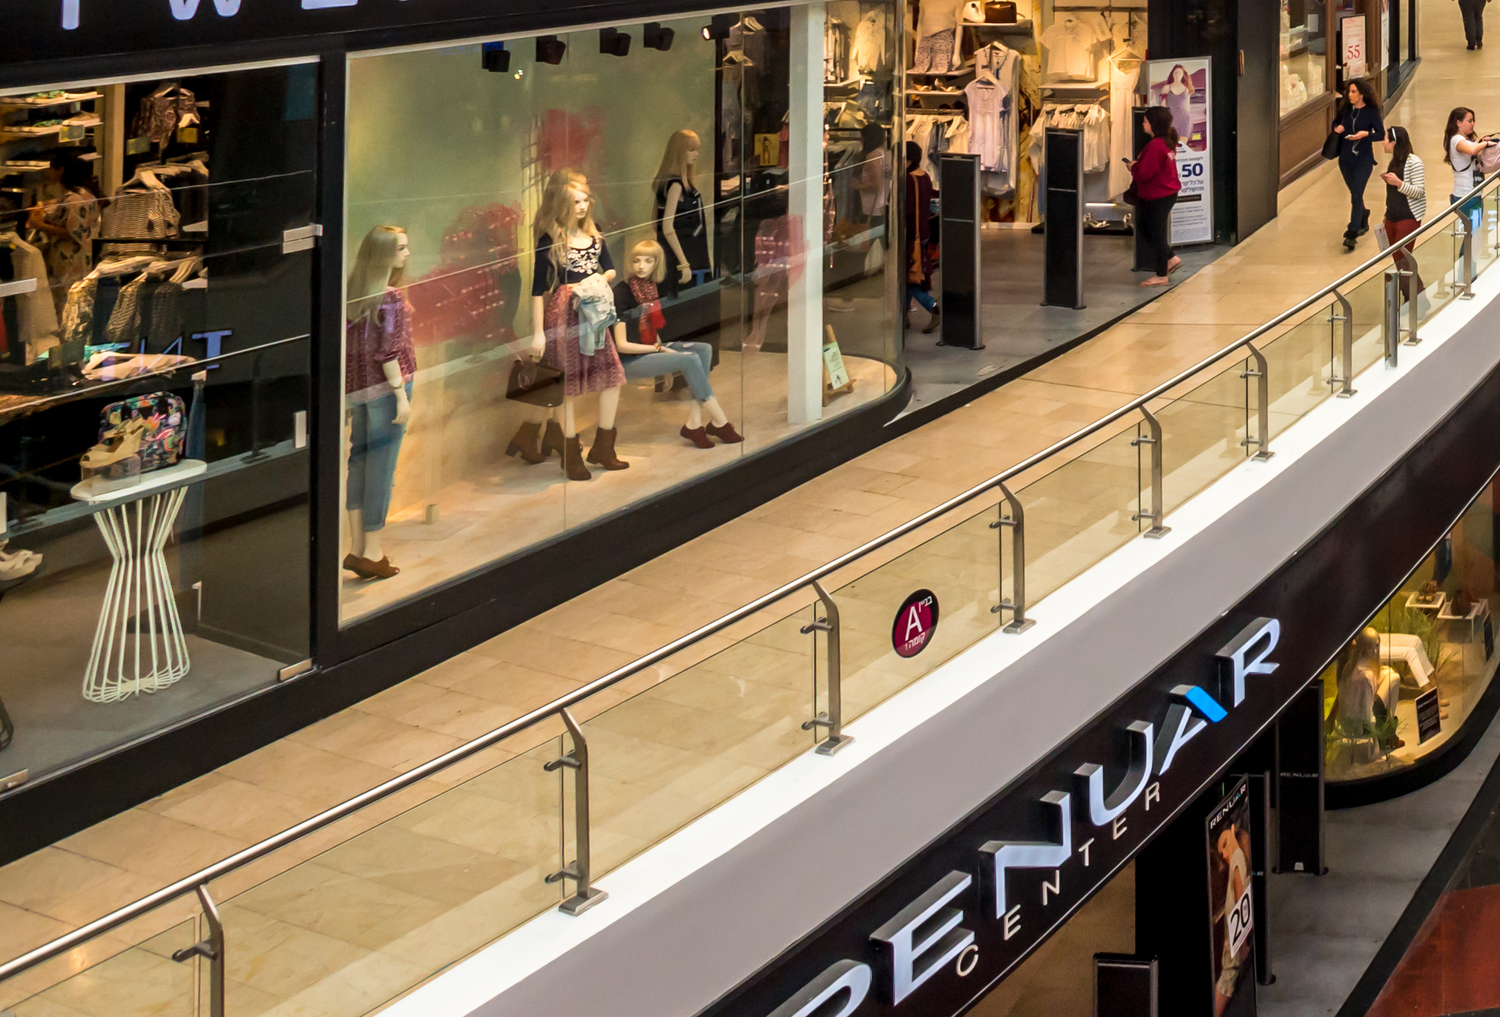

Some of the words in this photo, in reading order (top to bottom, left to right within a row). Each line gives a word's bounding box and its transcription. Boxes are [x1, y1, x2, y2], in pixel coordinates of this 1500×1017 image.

[1347, 44, 1361, 60] 55
[1181, 162, 1204, 178] 50
[905, 605, 923, 642] A
[908, 632, 926, 650] קומה
[1210, 783, 1247, 830] RENUAR
[955, 781, 1161, 978] CENTER
[1230, 892, 1251, 947] 20
